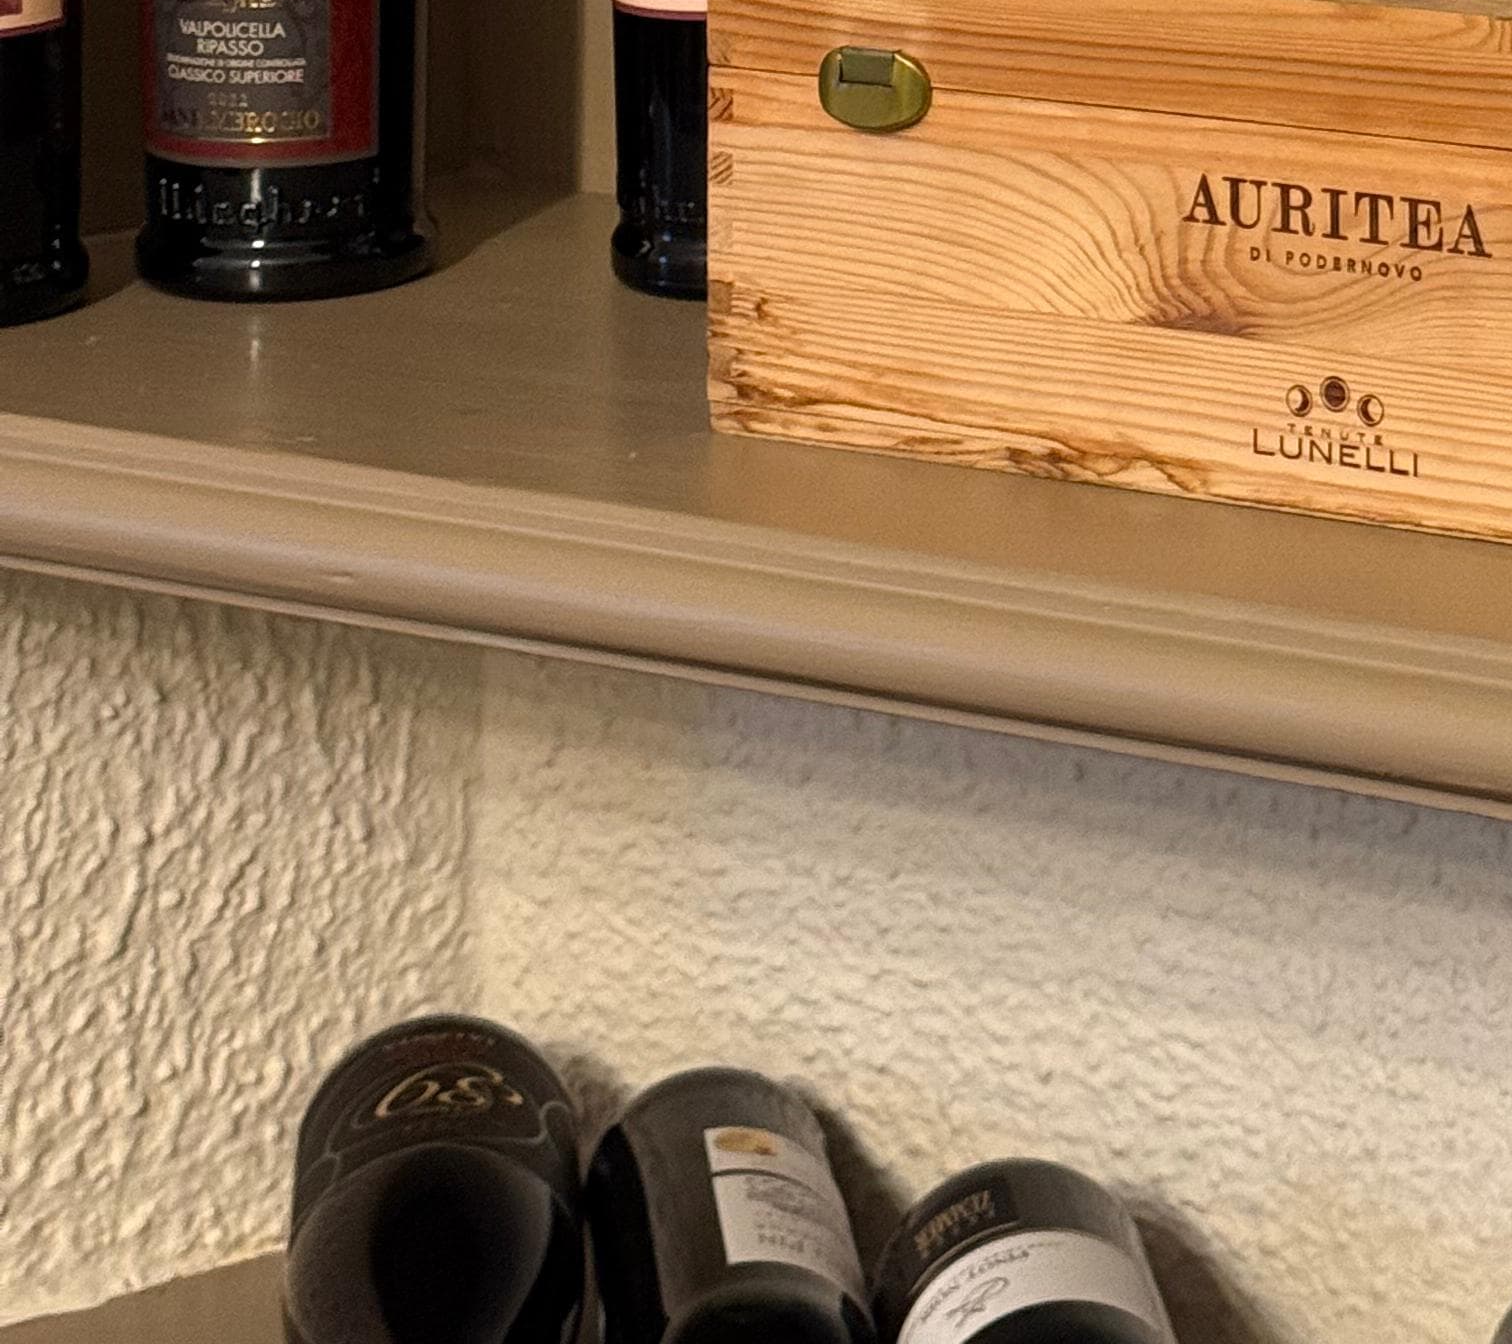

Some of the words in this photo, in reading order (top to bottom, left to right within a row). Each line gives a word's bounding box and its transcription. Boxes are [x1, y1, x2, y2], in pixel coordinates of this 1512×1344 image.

[179, 18, 286, 39] VALPOLICELLA
[197, 38, 265, 56] RIPASSO
[168, 64, 226, 84] CLASSICO
[228, 68, 305, 85] SUPERIORE
[1182, 173, 1493, 259] AURITEA
[1249, 246, 1272, 263] DI
[1284, 249, 1423, 282] PODERNOVO
[1286, 422, 1384, 447] TENUTE
[1252, 427, 1420, 478] LUNELLI
